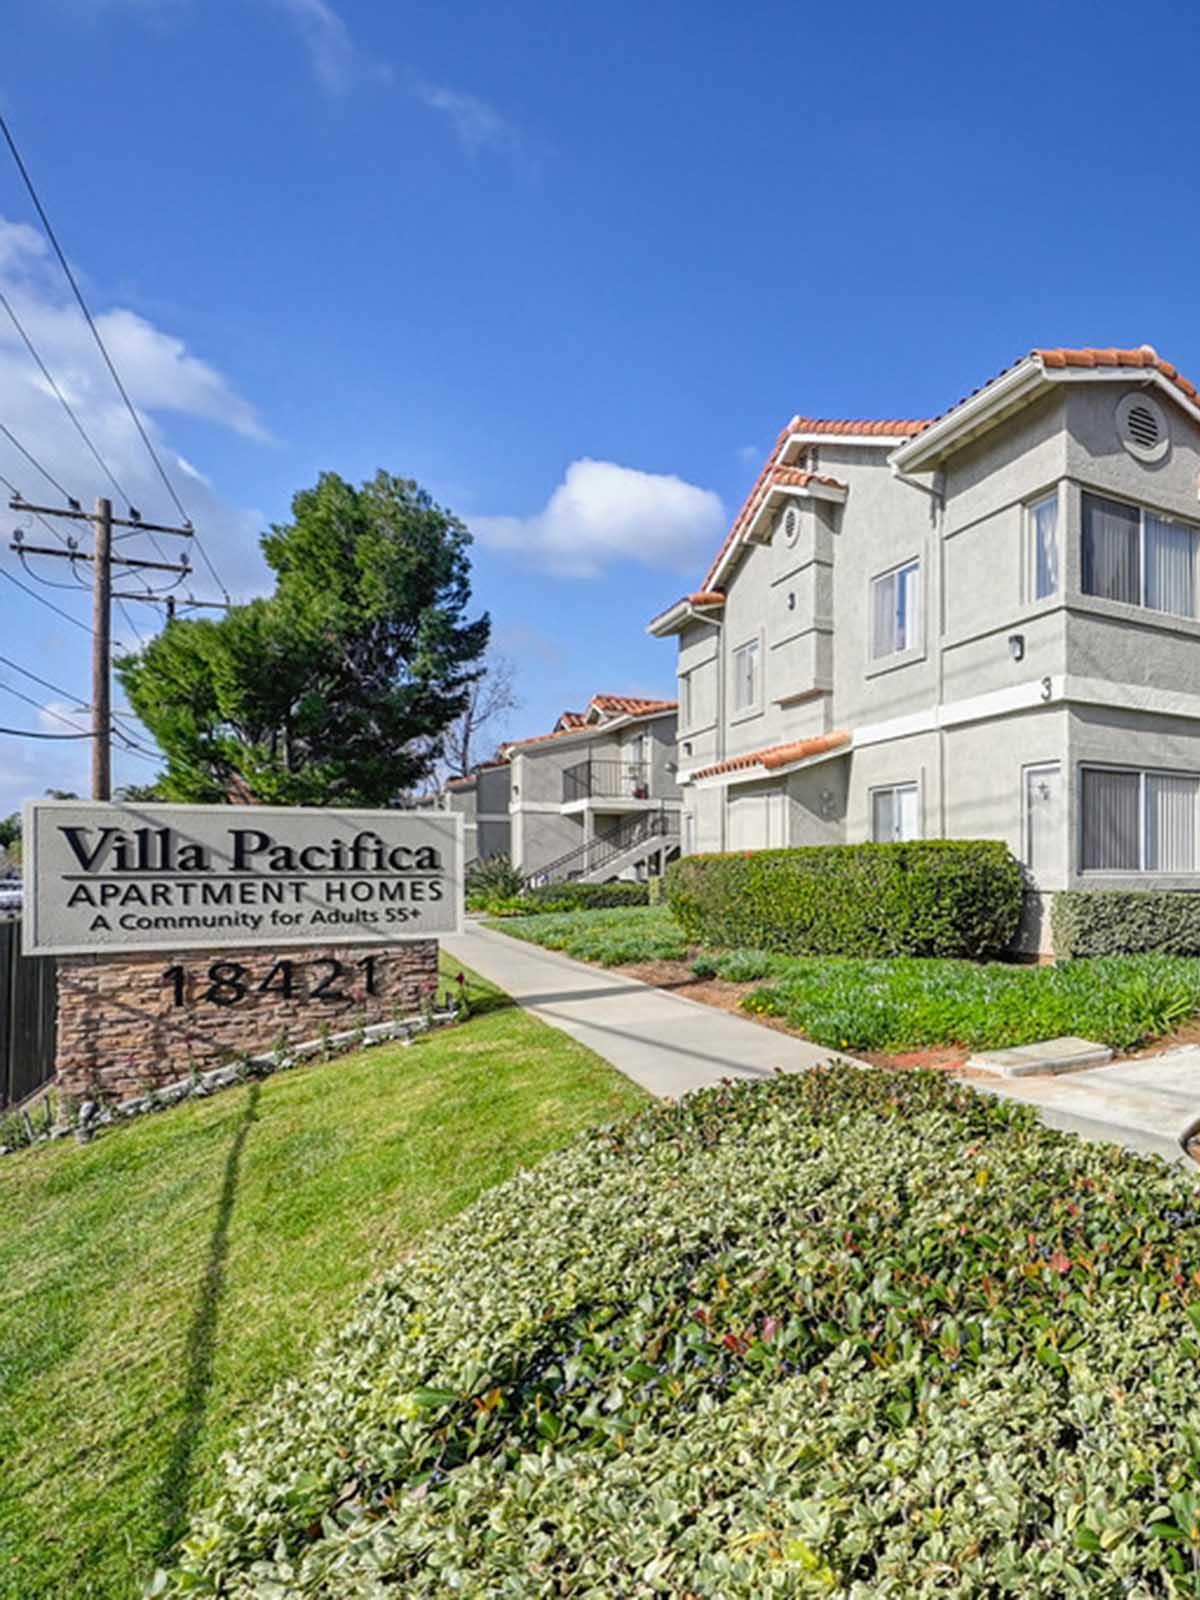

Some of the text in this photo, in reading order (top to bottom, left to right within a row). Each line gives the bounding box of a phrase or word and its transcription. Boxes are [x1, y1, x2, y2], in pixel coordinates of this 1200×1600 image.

[1041, 676, 1052, 700] 3
[57, 826, 443, 872] Villa Pacifica
[67, 880, 443, 908] APARTMENT HOMES
[90, 906, 421, 931] A Community for Adults 55+
[163, 955, 385, 1008] 18421
